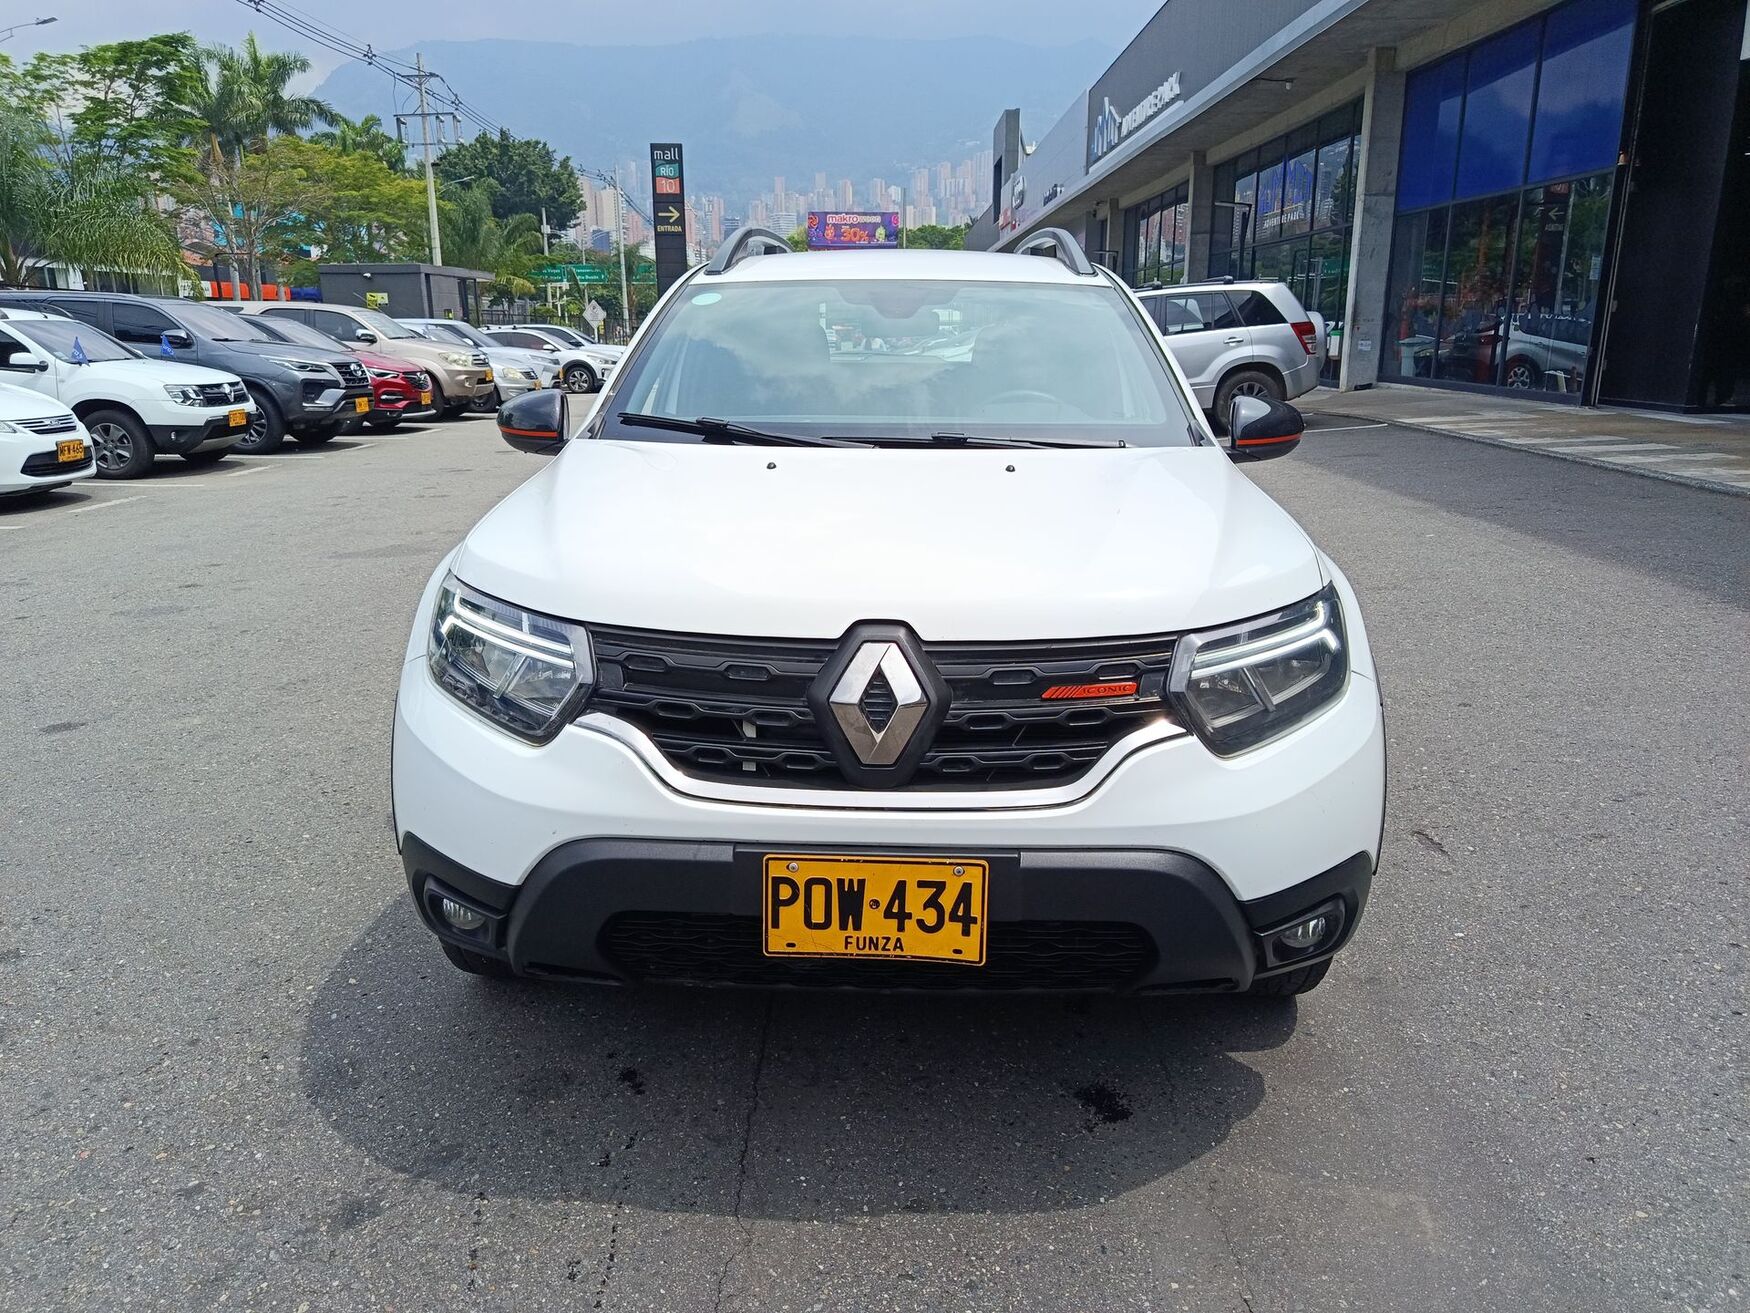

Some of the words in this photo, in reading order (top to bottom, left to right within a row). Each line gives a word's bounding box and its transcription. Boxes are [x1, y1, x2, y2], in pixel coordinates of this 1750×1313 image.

[654, 147, 679, 160] mall
[660, 165, 674, 176] RÍO
[661, 180, 675, 193] 10
[1083, 685, 1130, 695] ICONIC
[844, 935, 904, 952] FUNZA
